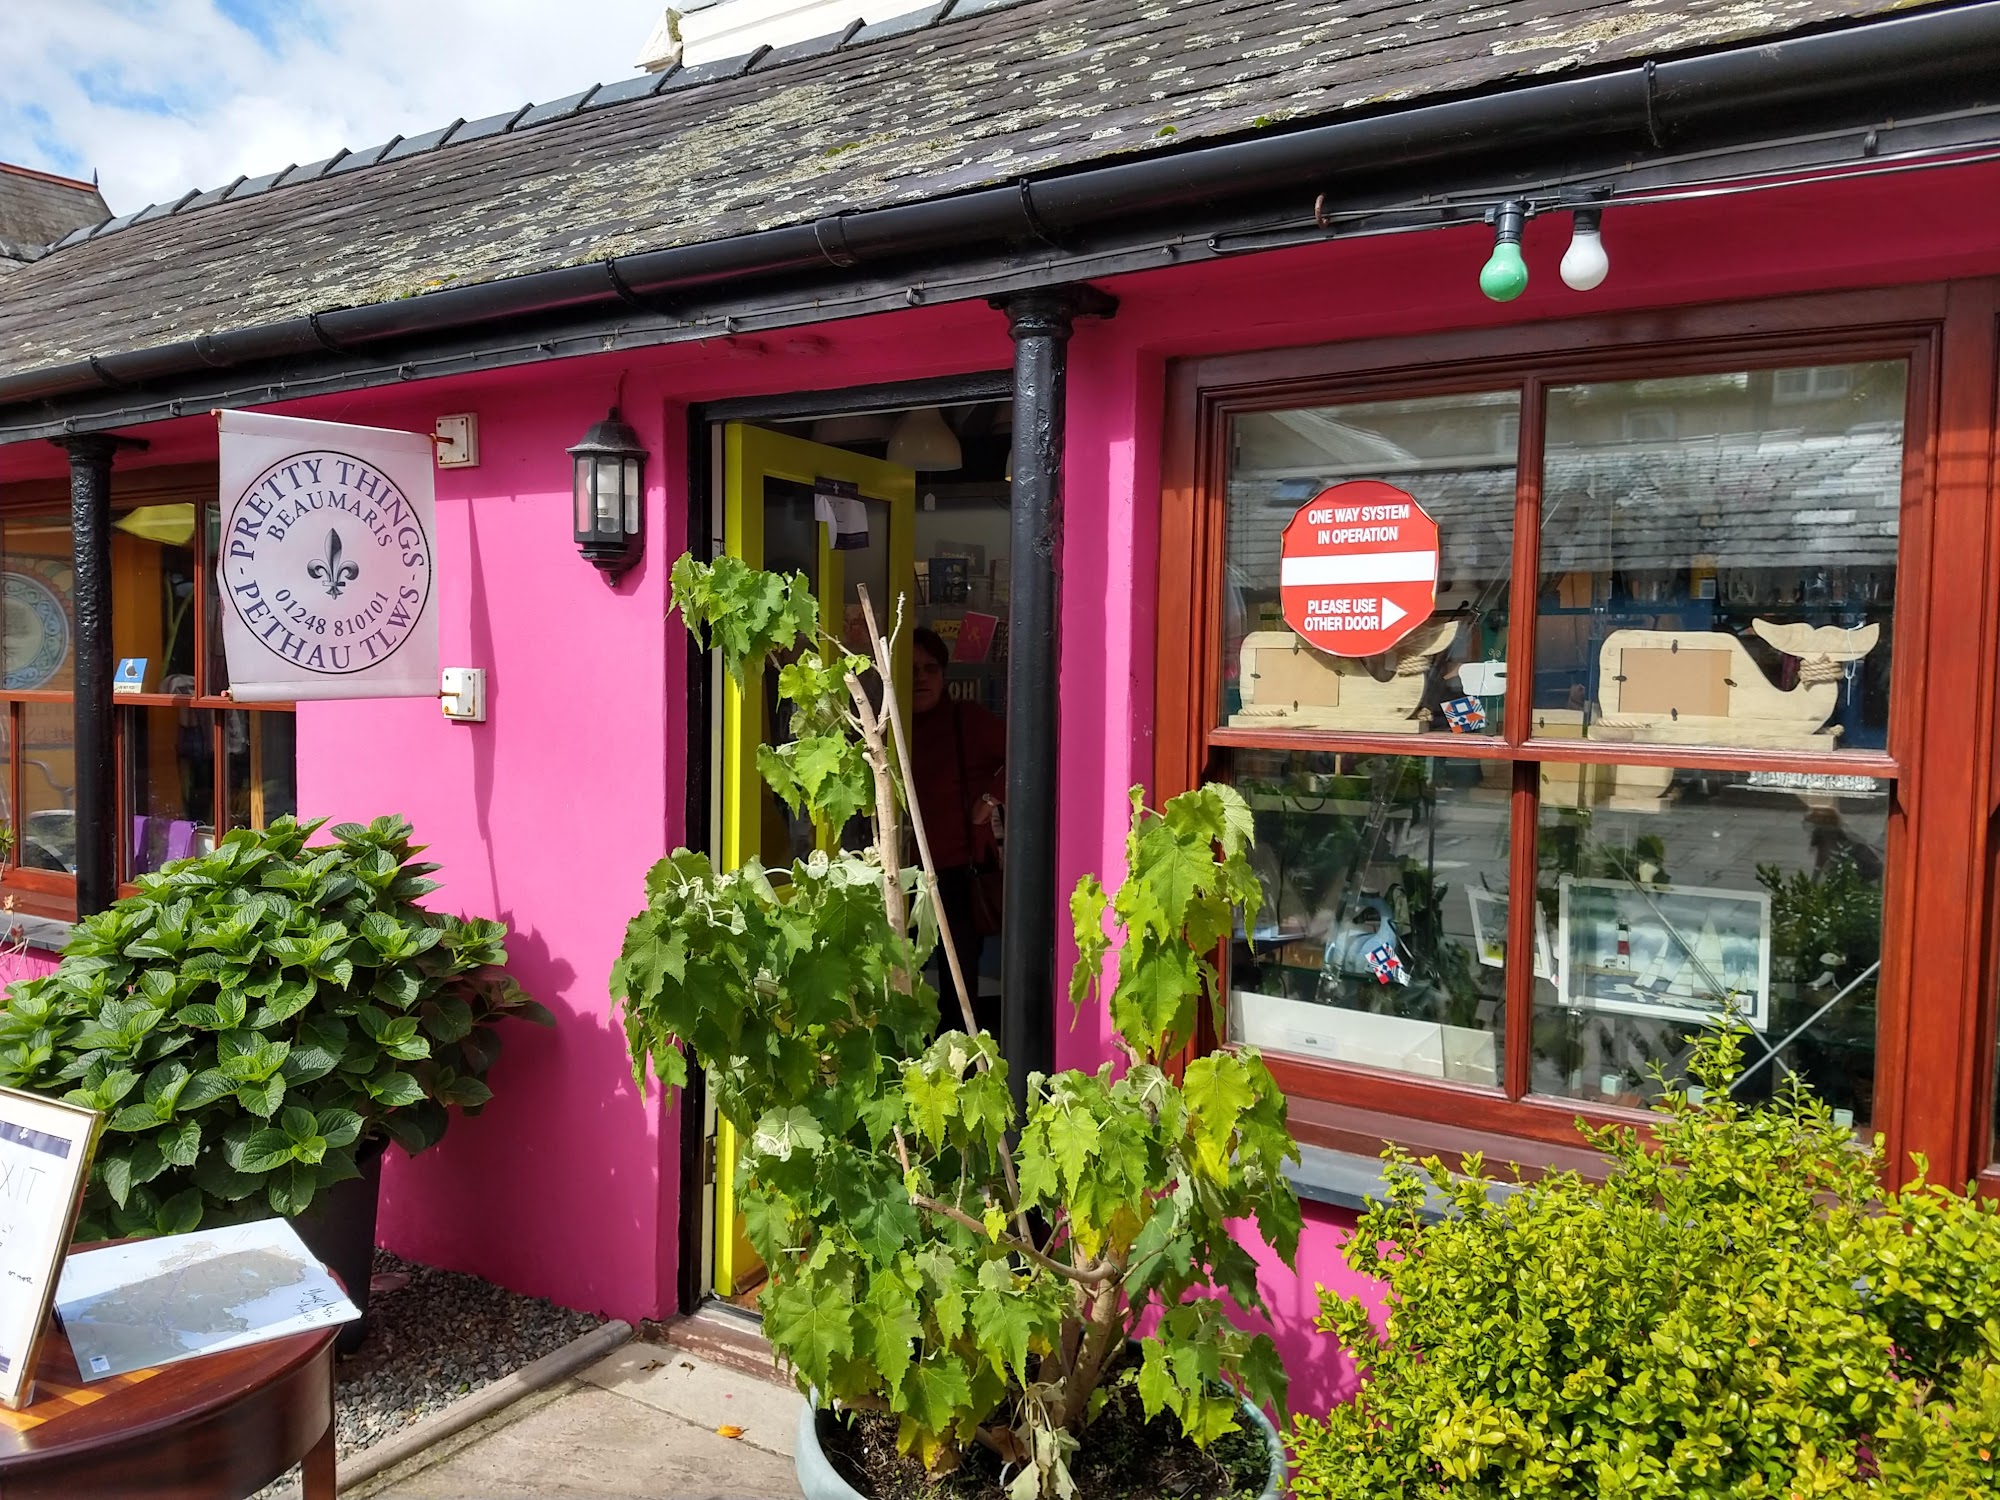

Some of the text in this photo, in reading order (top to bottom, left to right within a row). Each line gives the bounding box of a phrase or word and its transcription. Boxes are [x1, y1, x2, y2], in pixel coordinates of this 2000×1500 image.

[230, 458, 424, 568] PRETTY THINGS
[266, 490, 393, 548] BEAUMARIS
[1308, 504, 1410, 525] ONE WAY SYSTEM
[1317, 526, 1399, 545] IN OPERATION
[275, 589, 389, 637] 01248 810101
[1304, 615, 1379, 631] OTHER DOOR
[1307, 598, 1377, 615] PLEASE USE
[233, 579, 420, 669] PETHAU TLWS
